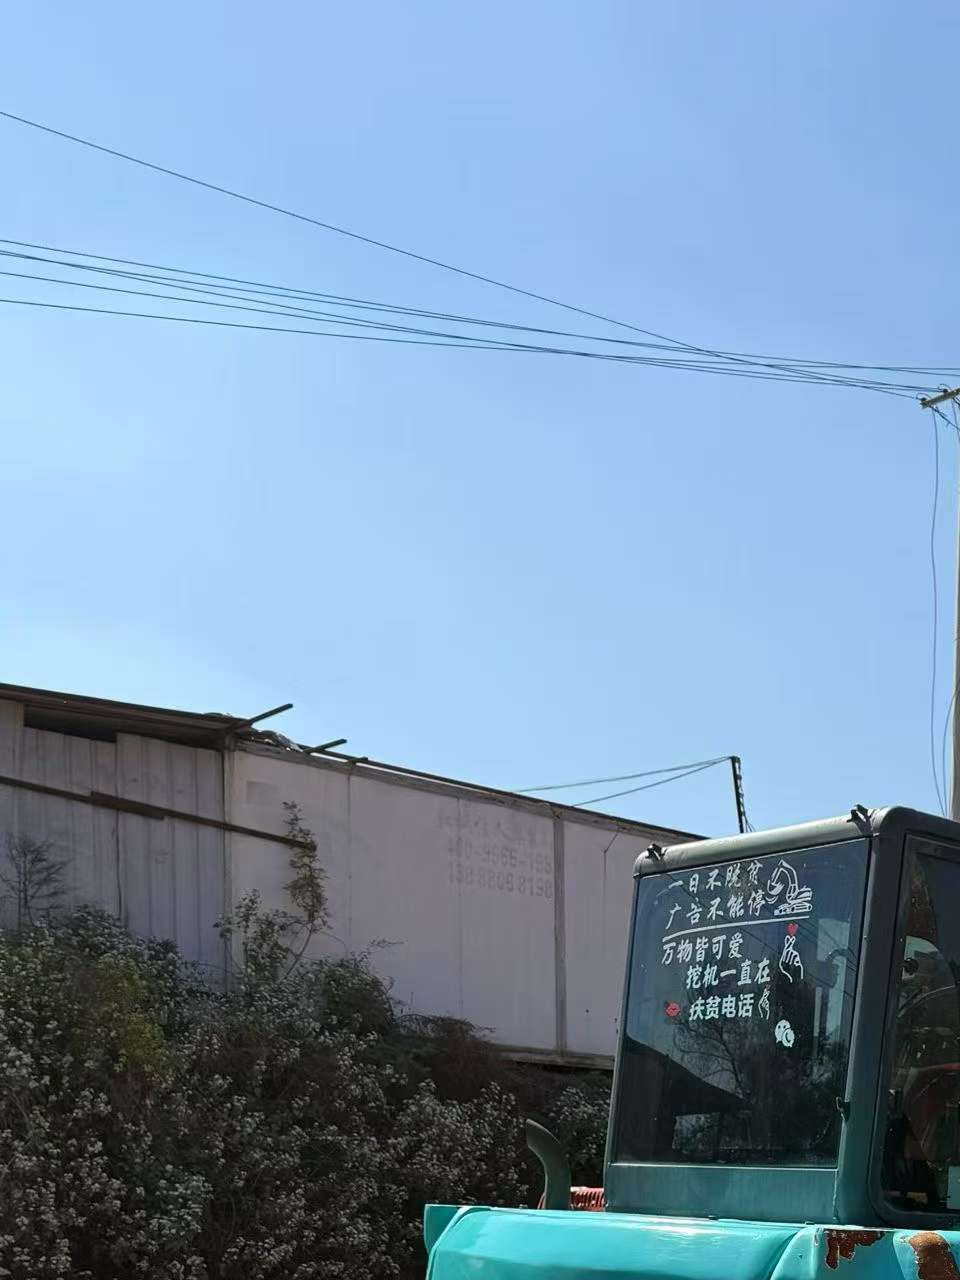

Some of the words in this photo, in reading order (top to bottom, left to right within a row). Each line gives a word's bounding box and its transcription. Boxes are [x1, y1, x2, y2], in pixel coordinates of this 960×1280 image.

[668, 860, 763, 893] 一日不脱贫
[665, 889, 766, 930] 广告不能停
[661, 932, 744, 965] 万物皆可爱
[686, 957, 771, 989] 挖机一直在
[688, 993, 755, 1021] 扶贫电话
